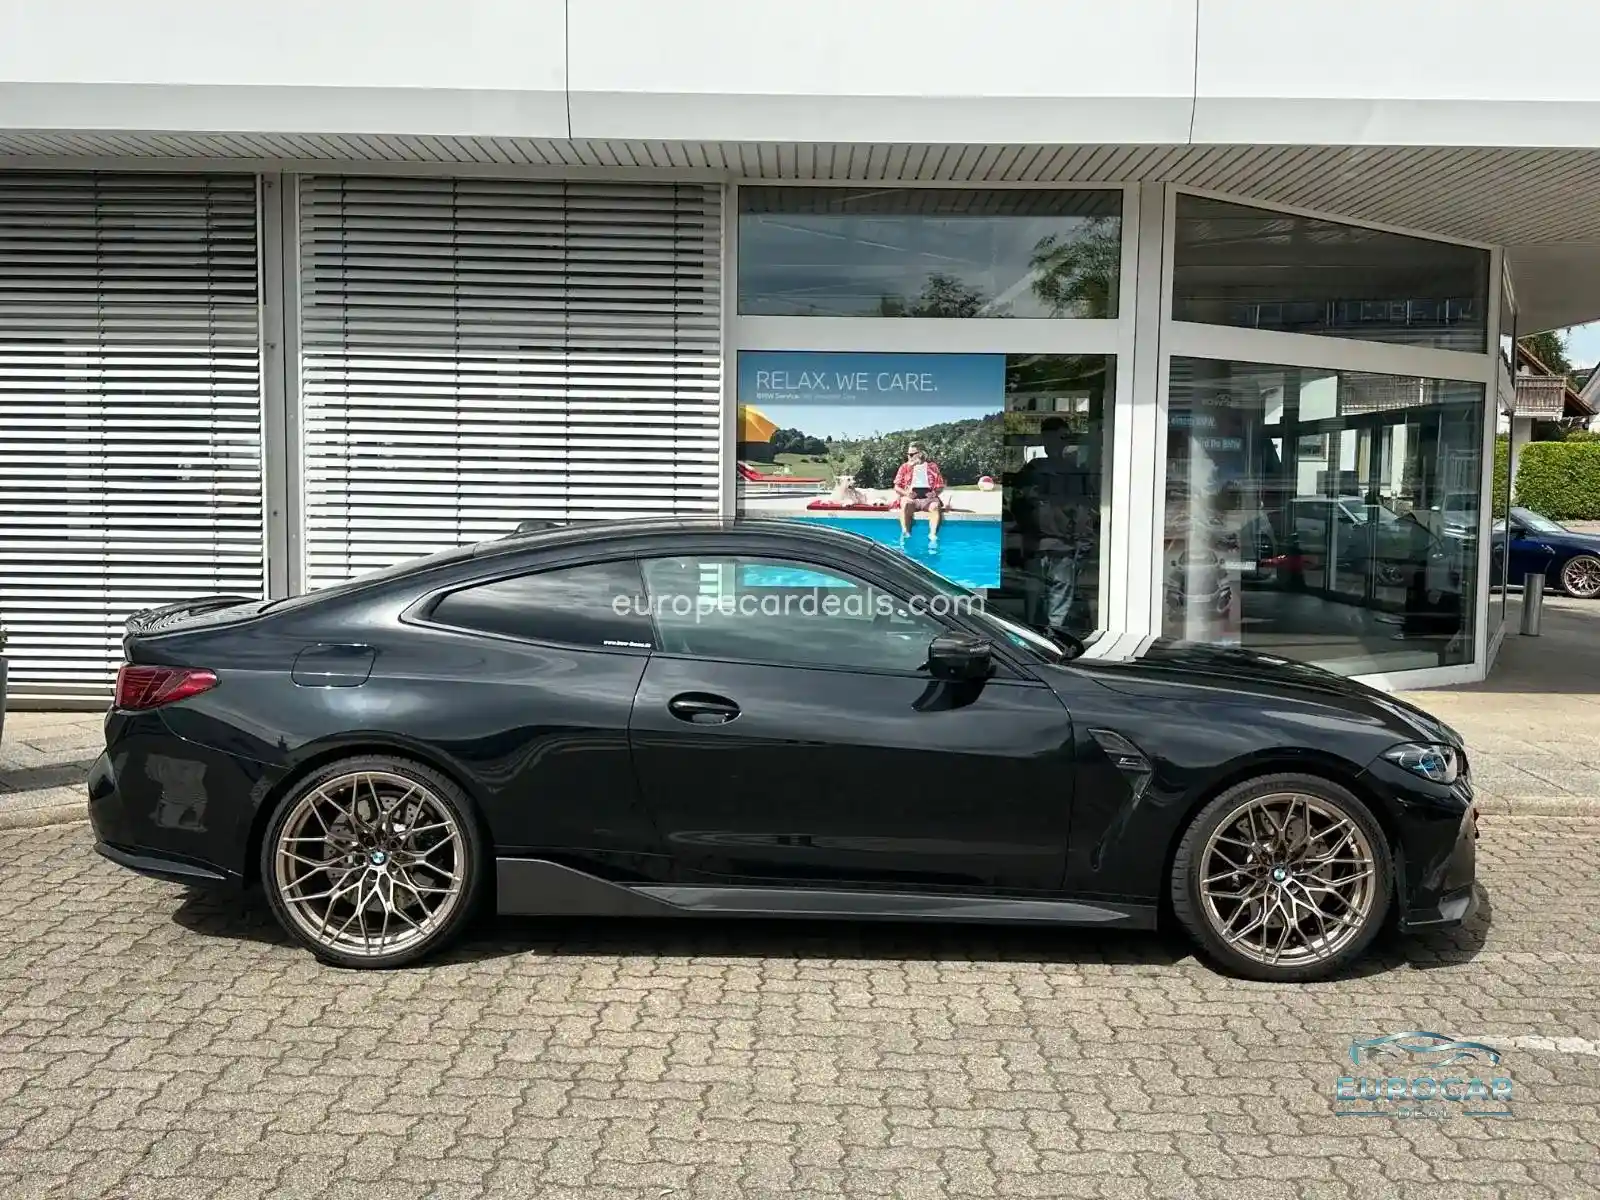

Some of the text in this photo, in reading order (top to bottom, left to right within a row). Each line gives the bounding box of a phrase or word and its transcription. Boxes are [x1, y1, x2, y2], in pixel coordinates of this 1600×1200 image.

[756, 371, 938, 392] RELAX. WE CARE.
